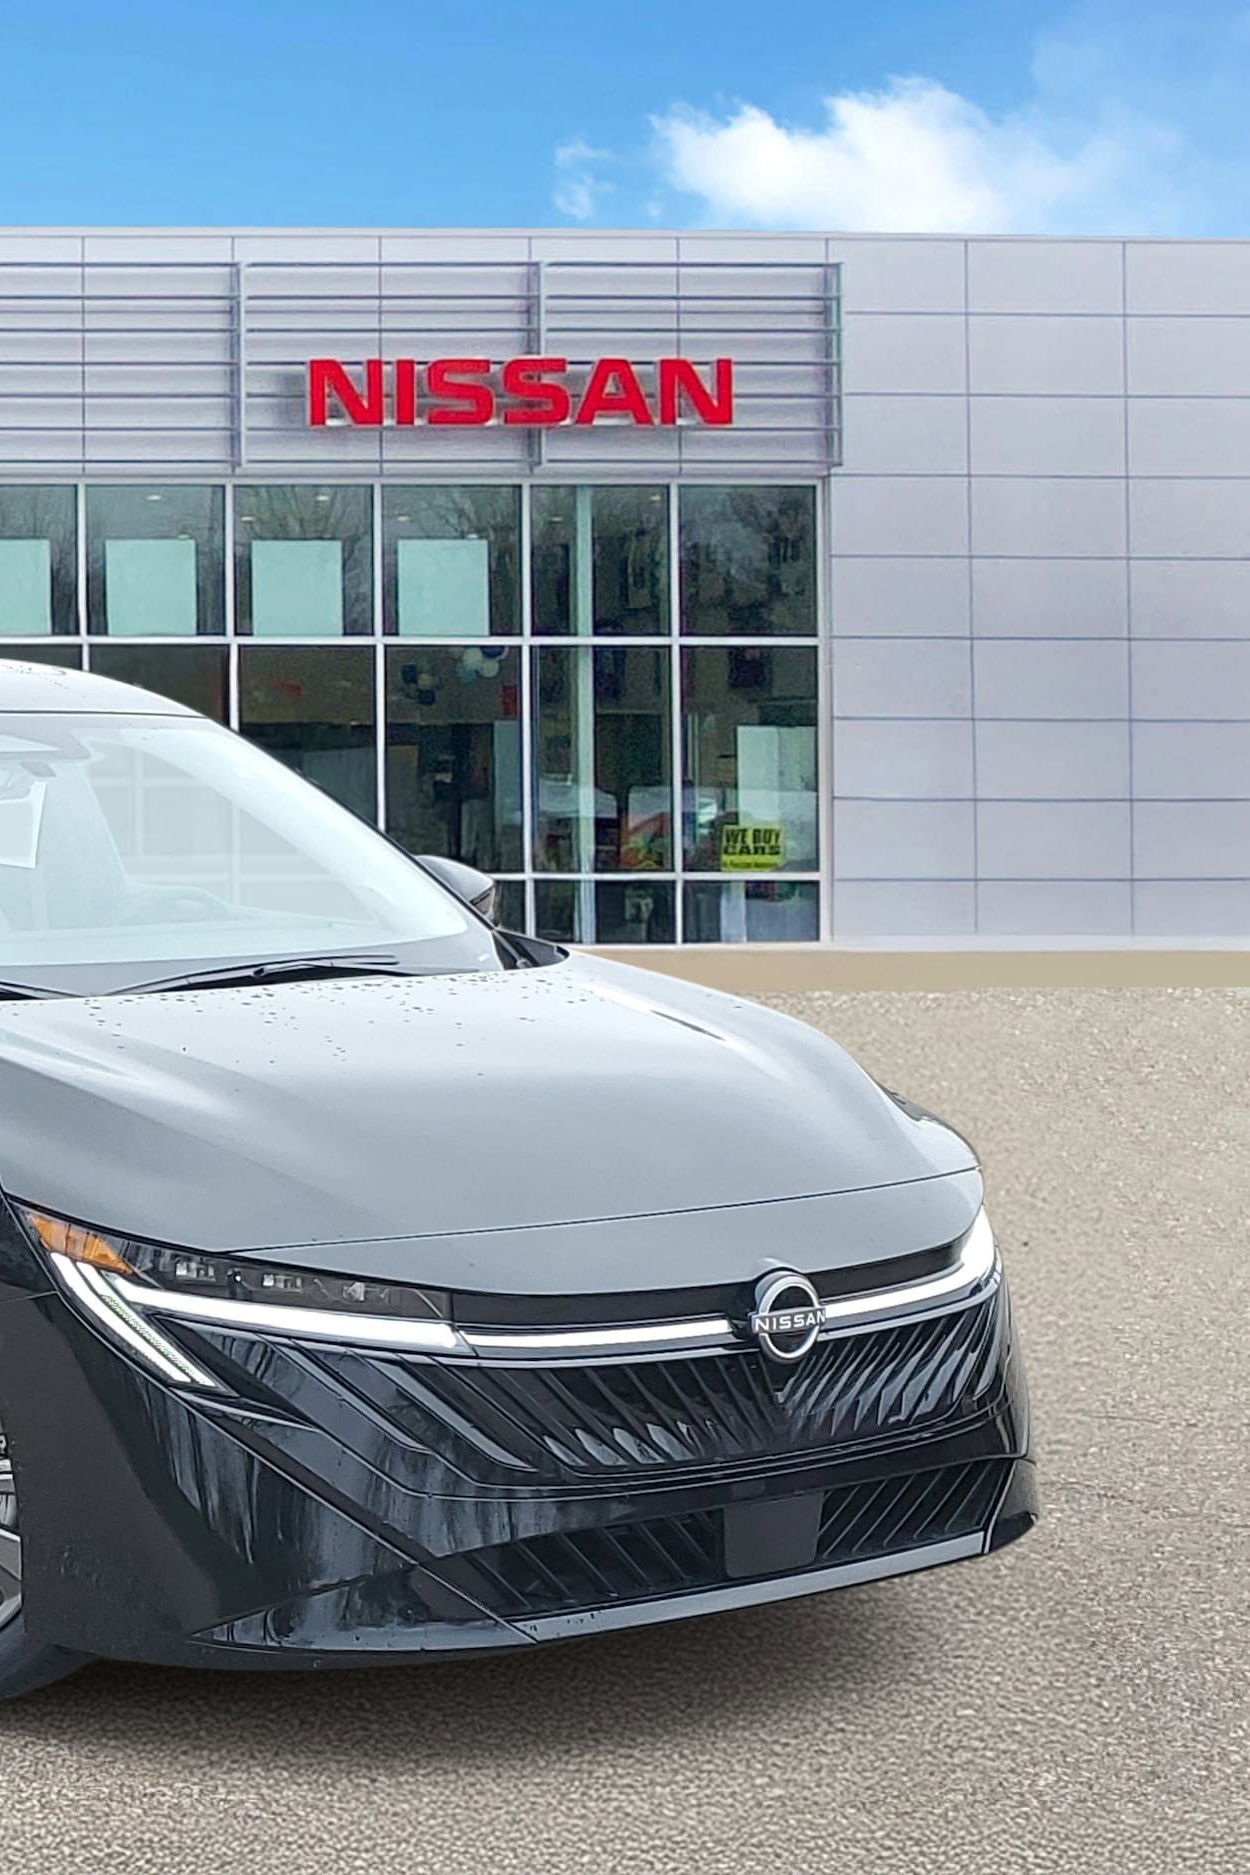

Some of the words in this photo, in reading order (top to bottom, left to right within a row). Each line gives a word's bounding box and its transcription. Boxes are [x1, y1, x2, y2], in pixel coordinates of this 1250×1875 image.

[308, 357, 734, 427] NISSAN
[725, 828, 748, 844] WE
[752, 828, 782, 845] BUY
[724, 844, 781, 856] CARS
[755, 1310, 826, 1331] NISSAN
